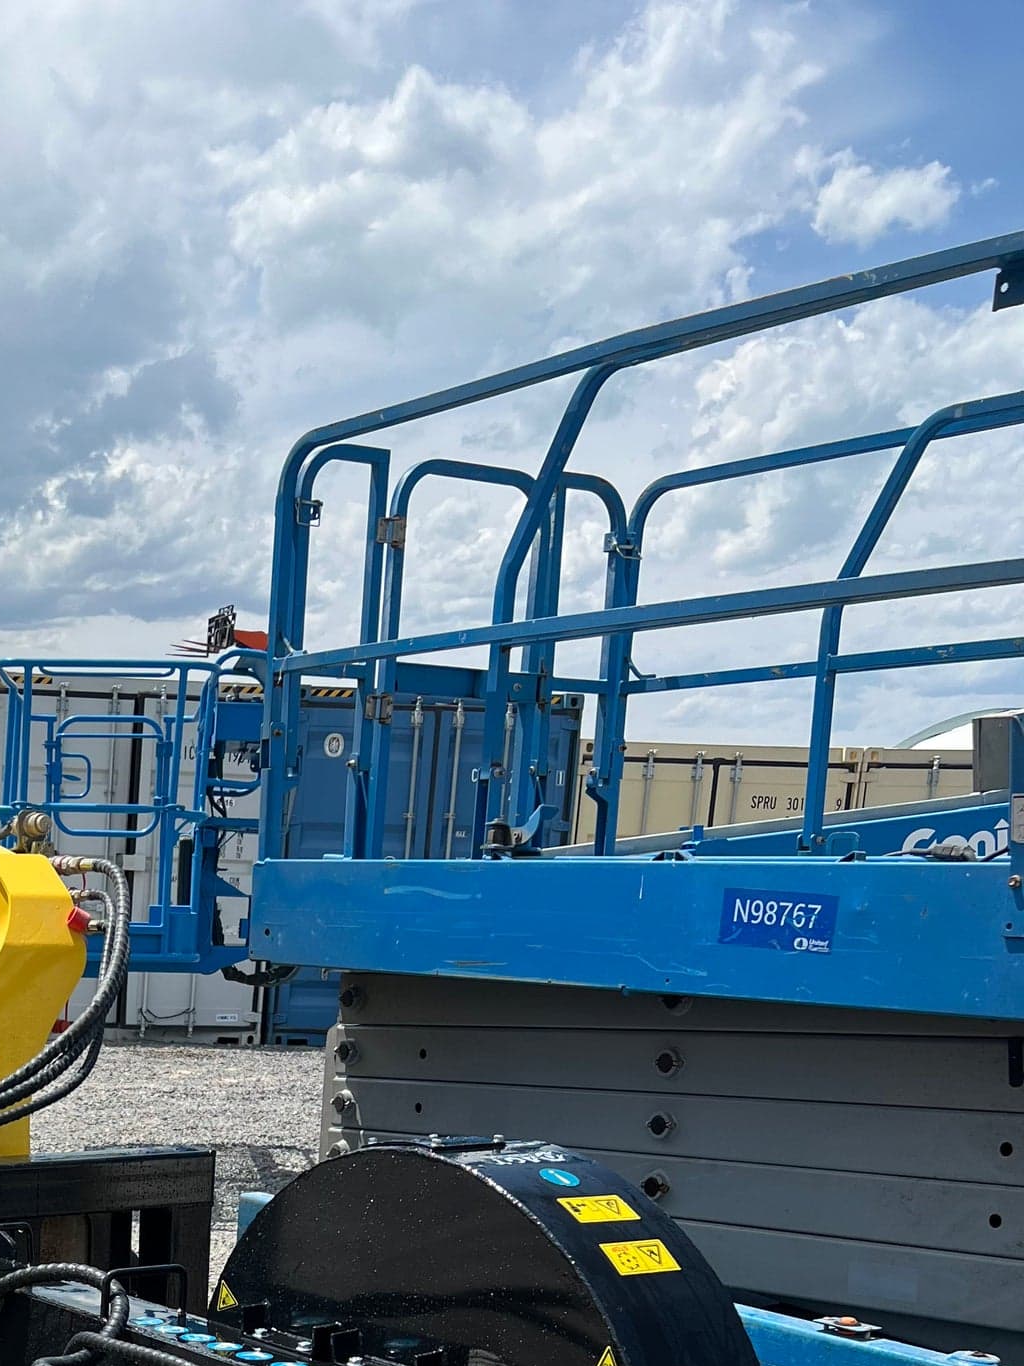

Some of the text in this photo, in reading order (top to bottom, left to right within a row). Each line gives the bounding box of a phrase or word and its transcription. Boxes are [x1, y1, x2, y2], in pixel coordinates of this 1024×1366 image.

[751, 796, 776, 810] SPRU
[787, 798, 805, 811] 301
[733, 898, 822, 929] N98767
